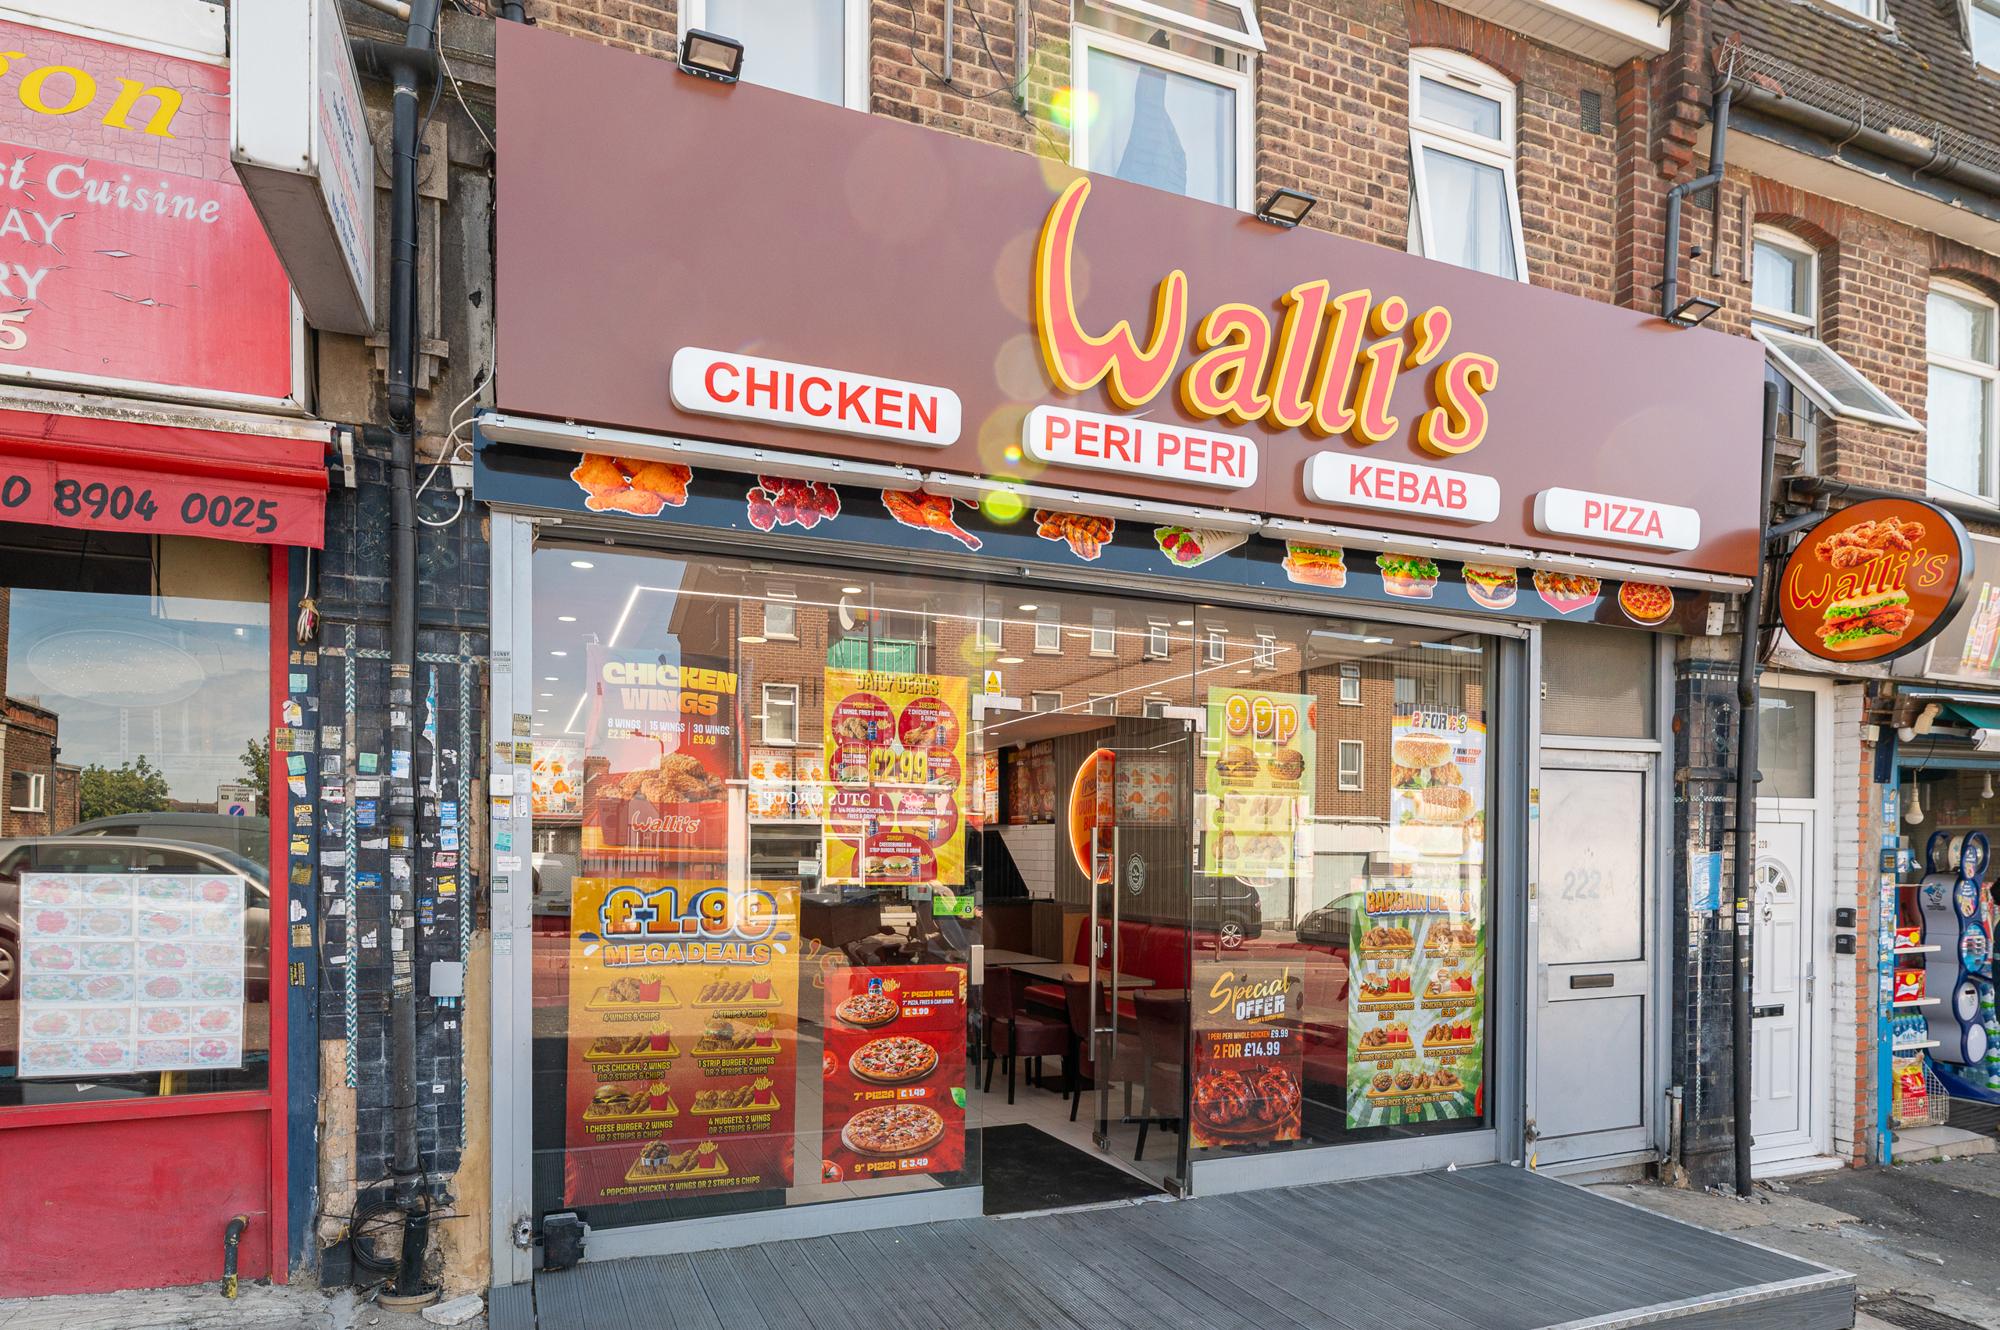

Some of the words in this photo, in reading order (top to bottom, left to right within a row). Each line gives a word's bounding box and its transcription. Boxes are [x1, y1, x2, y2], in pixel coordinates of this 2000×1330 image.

[0, 51, 183, 139] on
[47, 163, 220, 223] Cuisine
[0, 208, 66, 246] AY
[1036, 177, 1499, 457] Walli's
[704, 361, 938, 434] CHICKEN
[1045, 415, 1142, 464] PERI
[1157, 432, 1246, 478] PERI
[1349, 463, 1468, 510] KEBAB
[53, 479, 158, 521] 8904
[181, 492, 278, 533] 0025
[1584, 500, 1664, 539] PIZZA
[1789, 547, 1949, 611] Walli's
[602, 661, 738, 695] CHICKEN
[856, 671, 894, 693] DAILY
[895, 674, 940, 697] DEALS
[620, 687, 719, 716] WINGS
[607, 718, 613, 728] 8
[615, 718, 641, 729] WINGS
[649, 720, 658, 731] 15
[660, 721, 686, 733] WINGS
[693, 724, 703, 734] 30
[704, 725, 730, 736] WINGS
[1226, 694, 1299, 746] 99p
[1412, 711, 1420, 727] 2
[1421, 712, 1448, 730] FOR
[693, 735, 716, 745] £9.49
[869, 747, 927, 784] £2.99
[602, 887, 776, 938] £1.99
[1365, 889, 1428, 915] BARGAIN
[604, 943, 686, 967] MEGA
[687, 942, 772, 966] DEALS
[1207, 966, 1290, 1015] Special
[609, 1012, 633, 1022] WINGS
[638, 1012, 660, 1021] CHIPS
[719, 1010, 741, 1019] STRIPS
[747, 1009, 768, 1018] CHIPS
[1235, 994, 1286, 1021] OFFER
[1211, 1032, 1222, 1040] PERI
[1233, 1031, 1250, 1039] WHOLE
[1250, 1030, 1269, 1038] CHICKEN
[1270, 1028, 1289, 1038] £9.99
[1213, 1044, 1220, 1058] 2
[1222, 1043, 1242, 1058] FOR
[1244, 1041, 1280, 1057] £14.99
[597, 1064, 611, 1072] PCS
[649, 1062, 671, 1071] WINGS
[703, 1059, 720, 1067] STRIP
[755, 1057, 775, 1065] WINGS
[705, 1068, 714, 1076] OR
[721, 1067, 745, 1076] STRIPS
[750, 1066, 768, 1074] CHIPS
[597, 1074, 606, 1082] OR
[614, 1072, 638, 1081] STRIPS
[643, 1071, 665, 1080] CHIPS
[865, 1090, 895, 1100] PIZZA
[909, 1088, 926, 1097] 1.49
[590, 1124, 615, 1133] CHEESE
[651, 1120, 673, 1129] WINGS
[709, 1126, 718, 1134] OR
[724, 1124, 746, 1133] STRIPS
[751, 1122, 771, 1131] CHIPS
[751, 1114, 771, 1123] WINGS
[596, 1133, 605, 1142] OR
[612, 1132, 636, 1141] STRIPS
[642, 1130, 663, 1139] CHIPS
[867, 1161, 896, 1171] PIZZA
[606, 1186, 637, 1196] POPCORN
[675, 1181, 697, 1191] WINGS
[698, 1180, 707, 1189] OR
[713, 1178, 735, 1188] STRIPS
[741, 1176, 760, 1185] CHIPS
